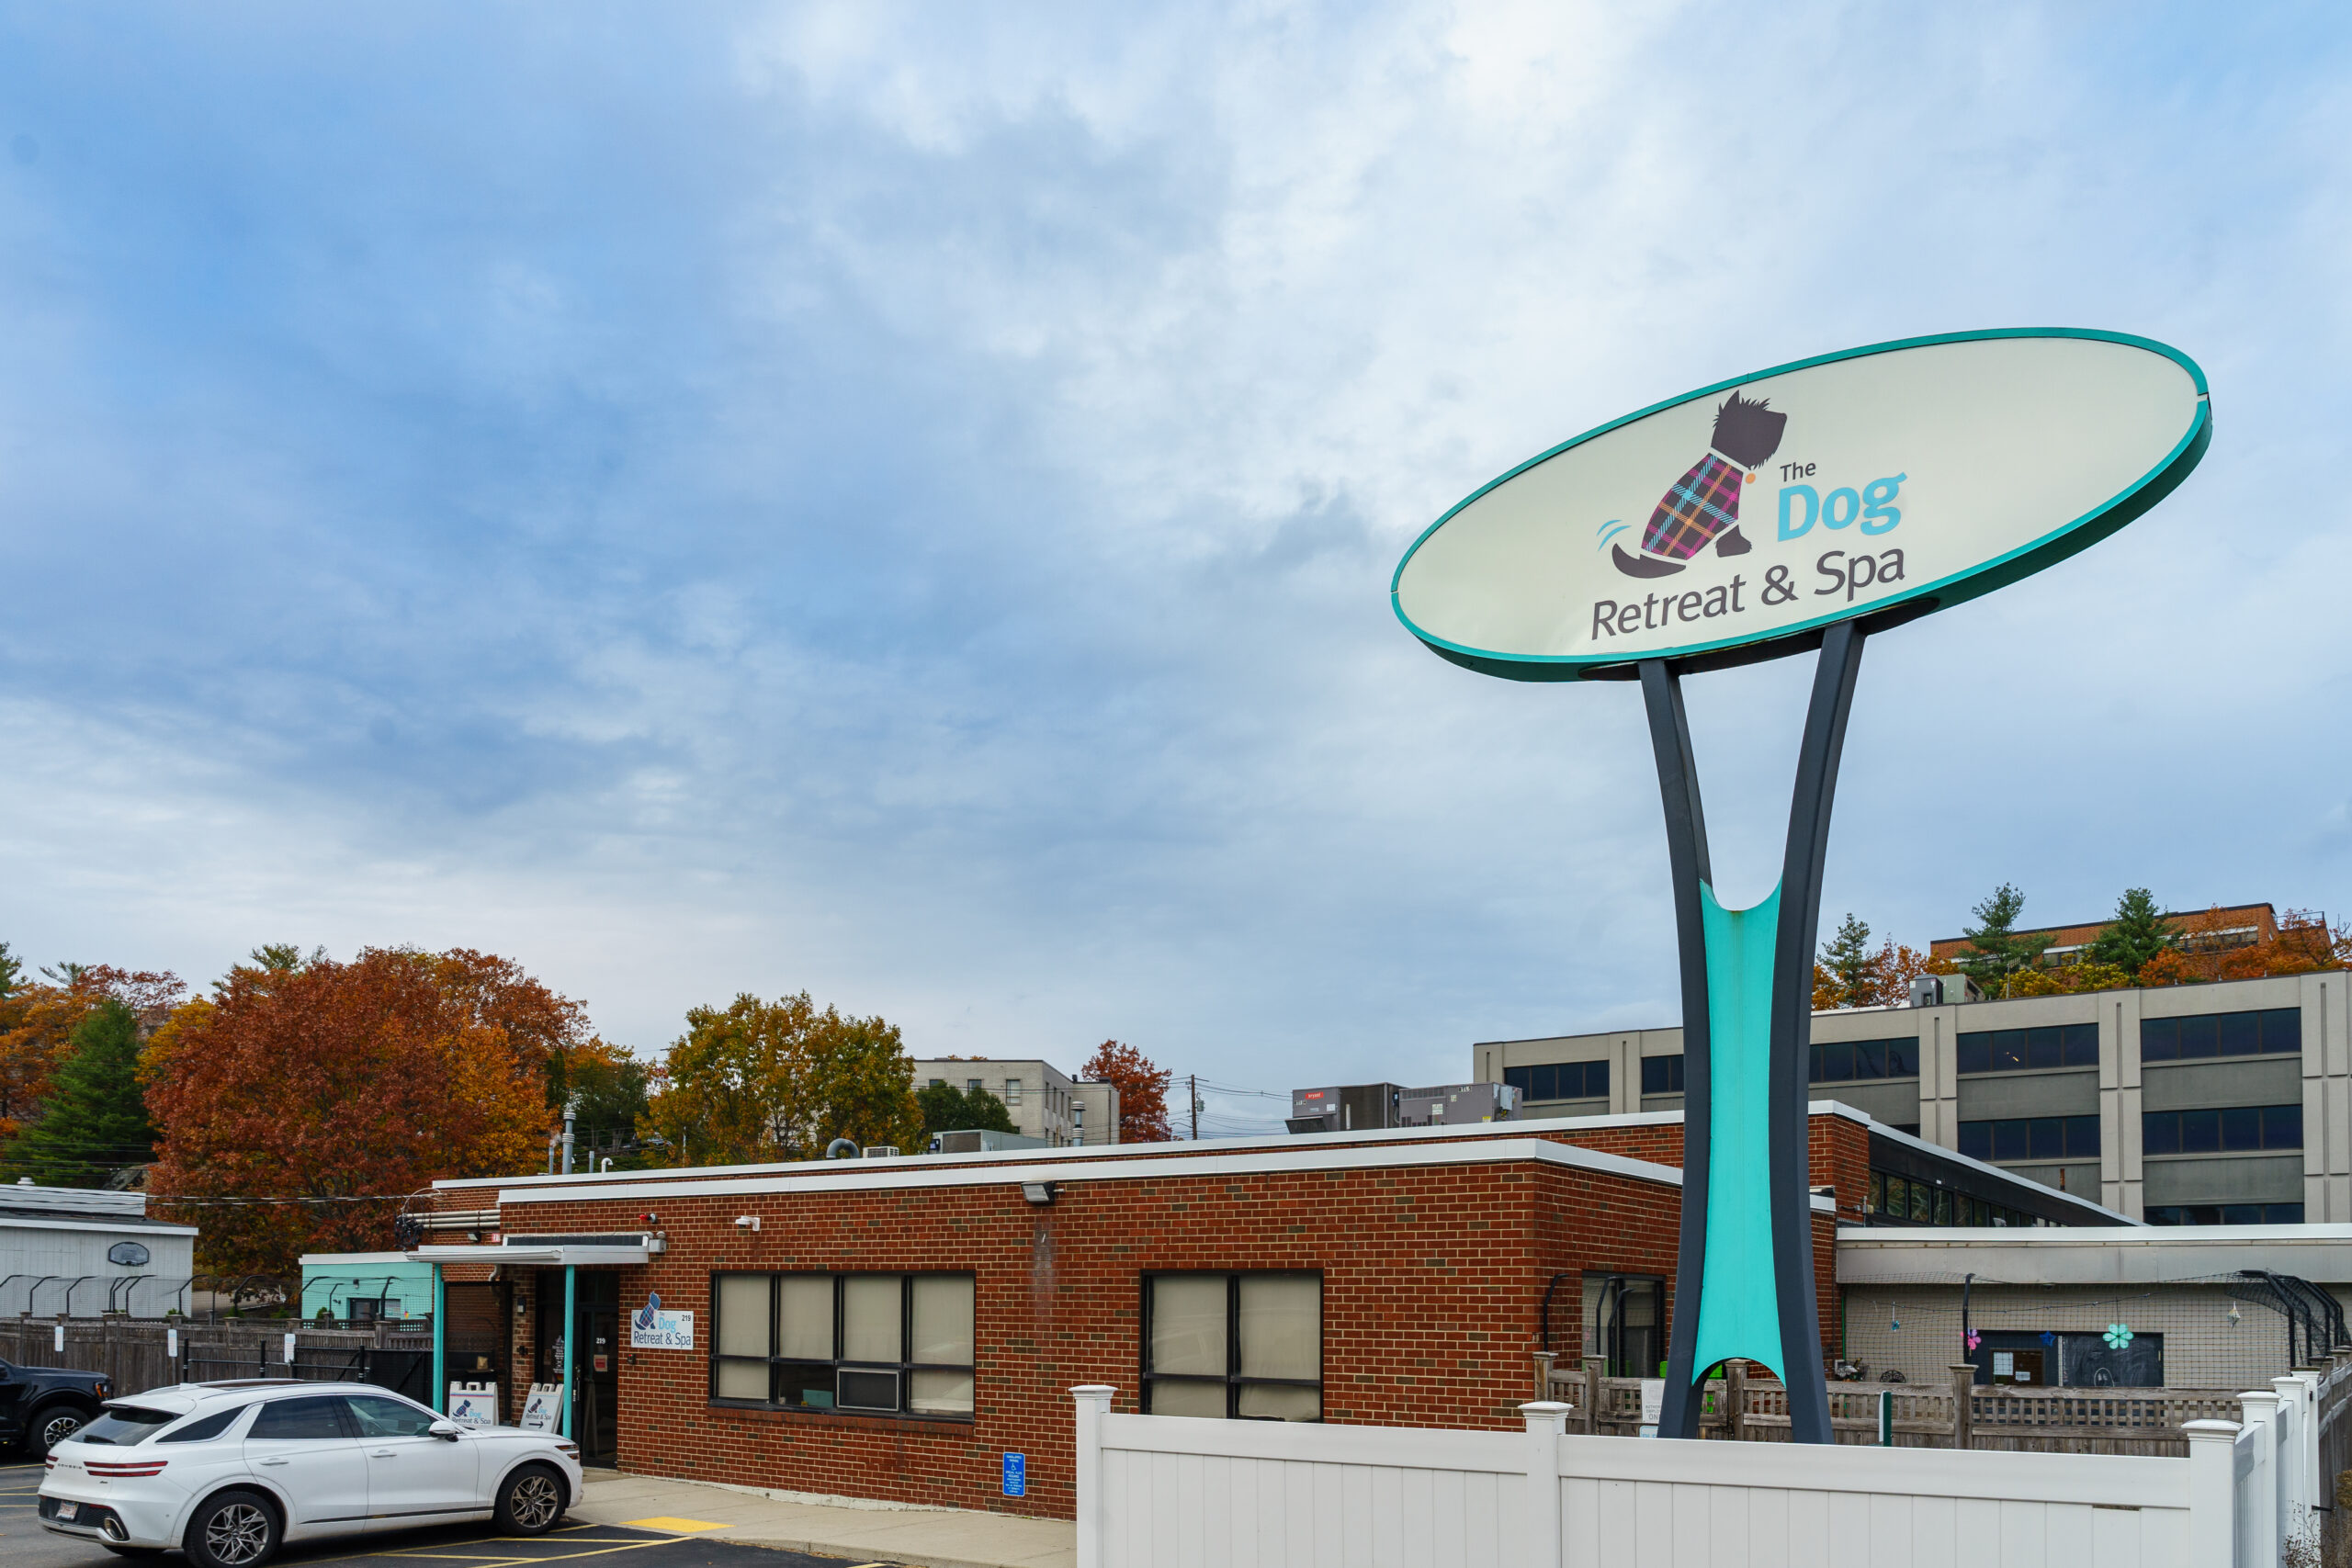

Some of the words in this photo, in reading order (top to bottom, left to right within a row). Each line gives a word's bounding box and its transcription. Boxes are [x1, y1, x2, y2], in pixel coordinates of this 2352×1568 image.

[1780, 462, 1816, 482] The
[1778, 472, 1907, 542] Dog
[1591, 573, 1747, 640] Retreat
[1760, 564, 1799, 606] &
[1814, 547, 1905, 603] Spa
[659, 1316, 676, 1334] Dog
[634, 1331, 663, 1344] Retreat
[665, 1332, 673, 1346] &
[675, 1333, 691, 1348] Spa
